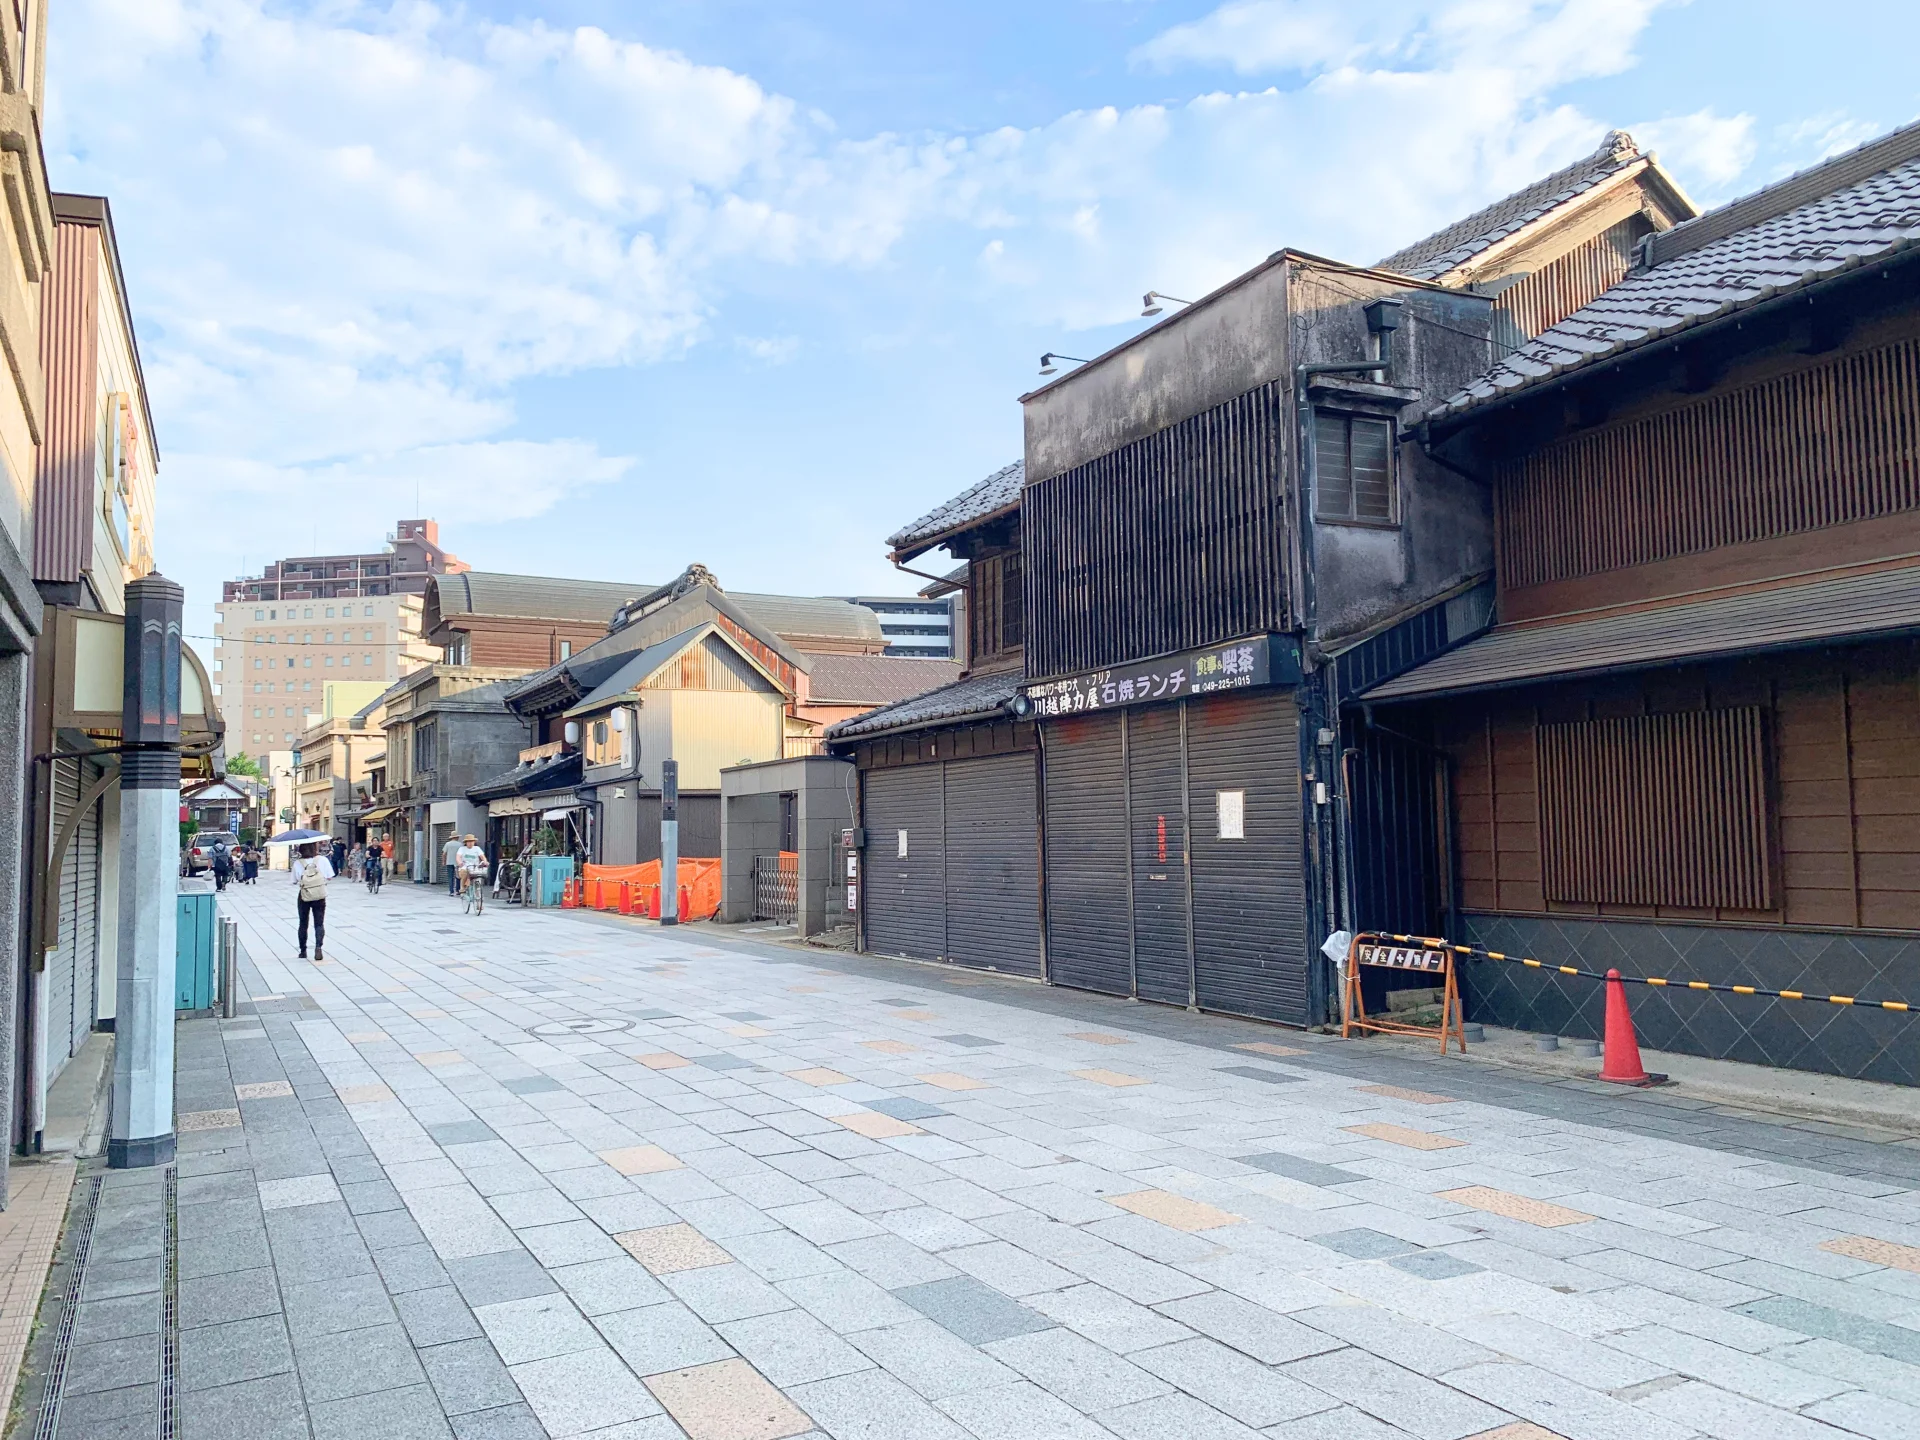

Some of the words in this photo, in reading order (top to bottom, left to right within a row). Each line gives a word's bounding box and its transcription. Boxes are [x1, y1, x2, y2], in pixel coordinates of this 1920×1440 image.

[1101, 668, 1186, 704] 石焼ランチ
[1202, 675, 1251, 692] 049-225-1015
